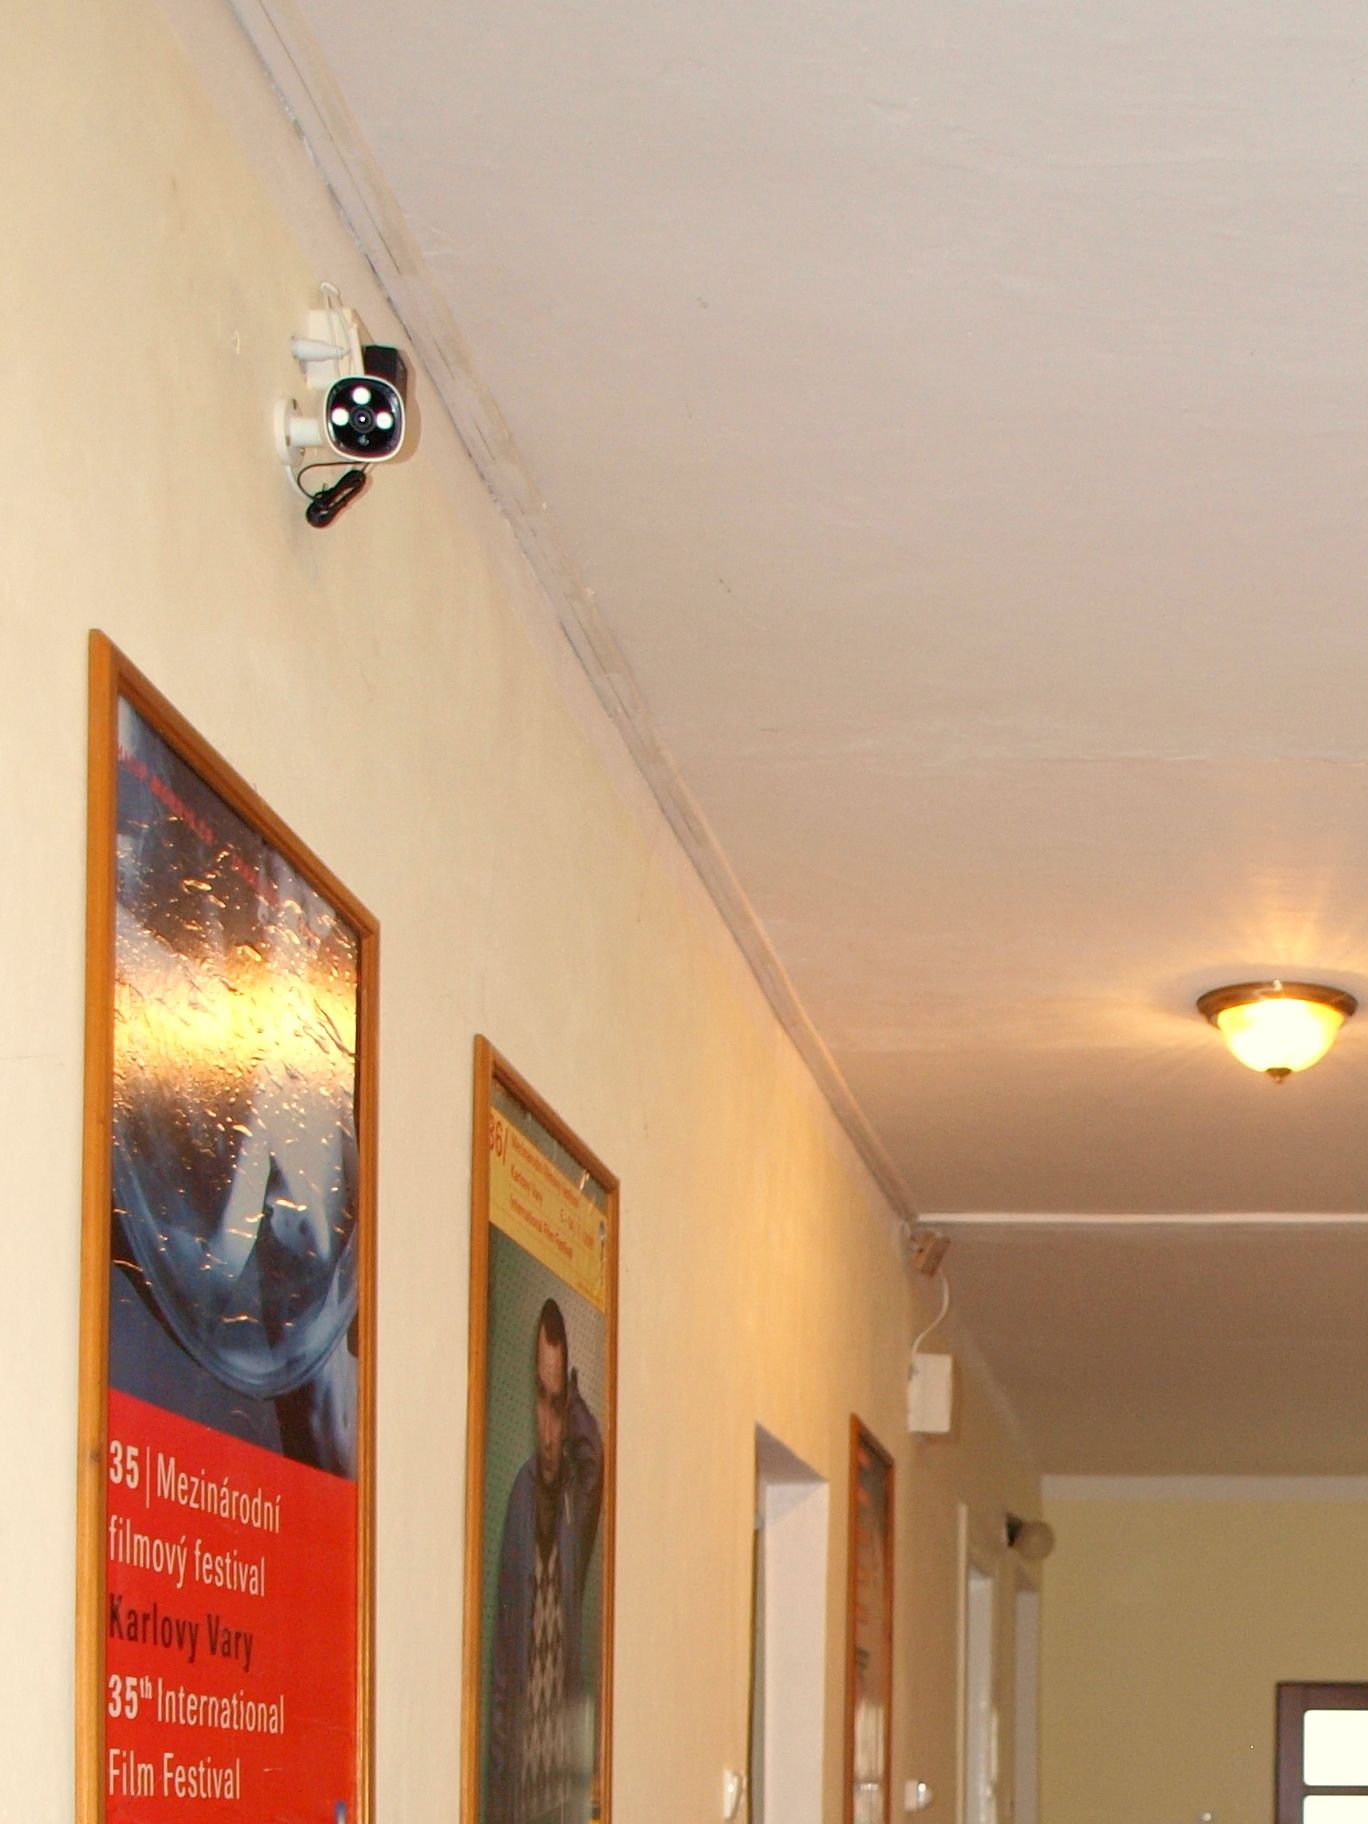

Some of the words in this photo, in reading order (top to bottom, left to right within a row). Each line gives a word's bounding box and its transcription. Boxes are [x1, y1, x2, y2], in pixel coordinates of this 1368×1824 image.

[109, 1440, 139, 1489] 35
[157, 1452, 281, 1533] Mezinárodní
[109, 1515, 187, 1589] filmový
[194, 1539, 265, 1597] festival
[109, 1594, 199, 1664] Karlovy
[206, 1613, 253, 1673] Vary
[157, 1677, 285, 1734] International
[109, 1749, 154, 1796] Film
[163, 1752, 240, 1800] Festival
